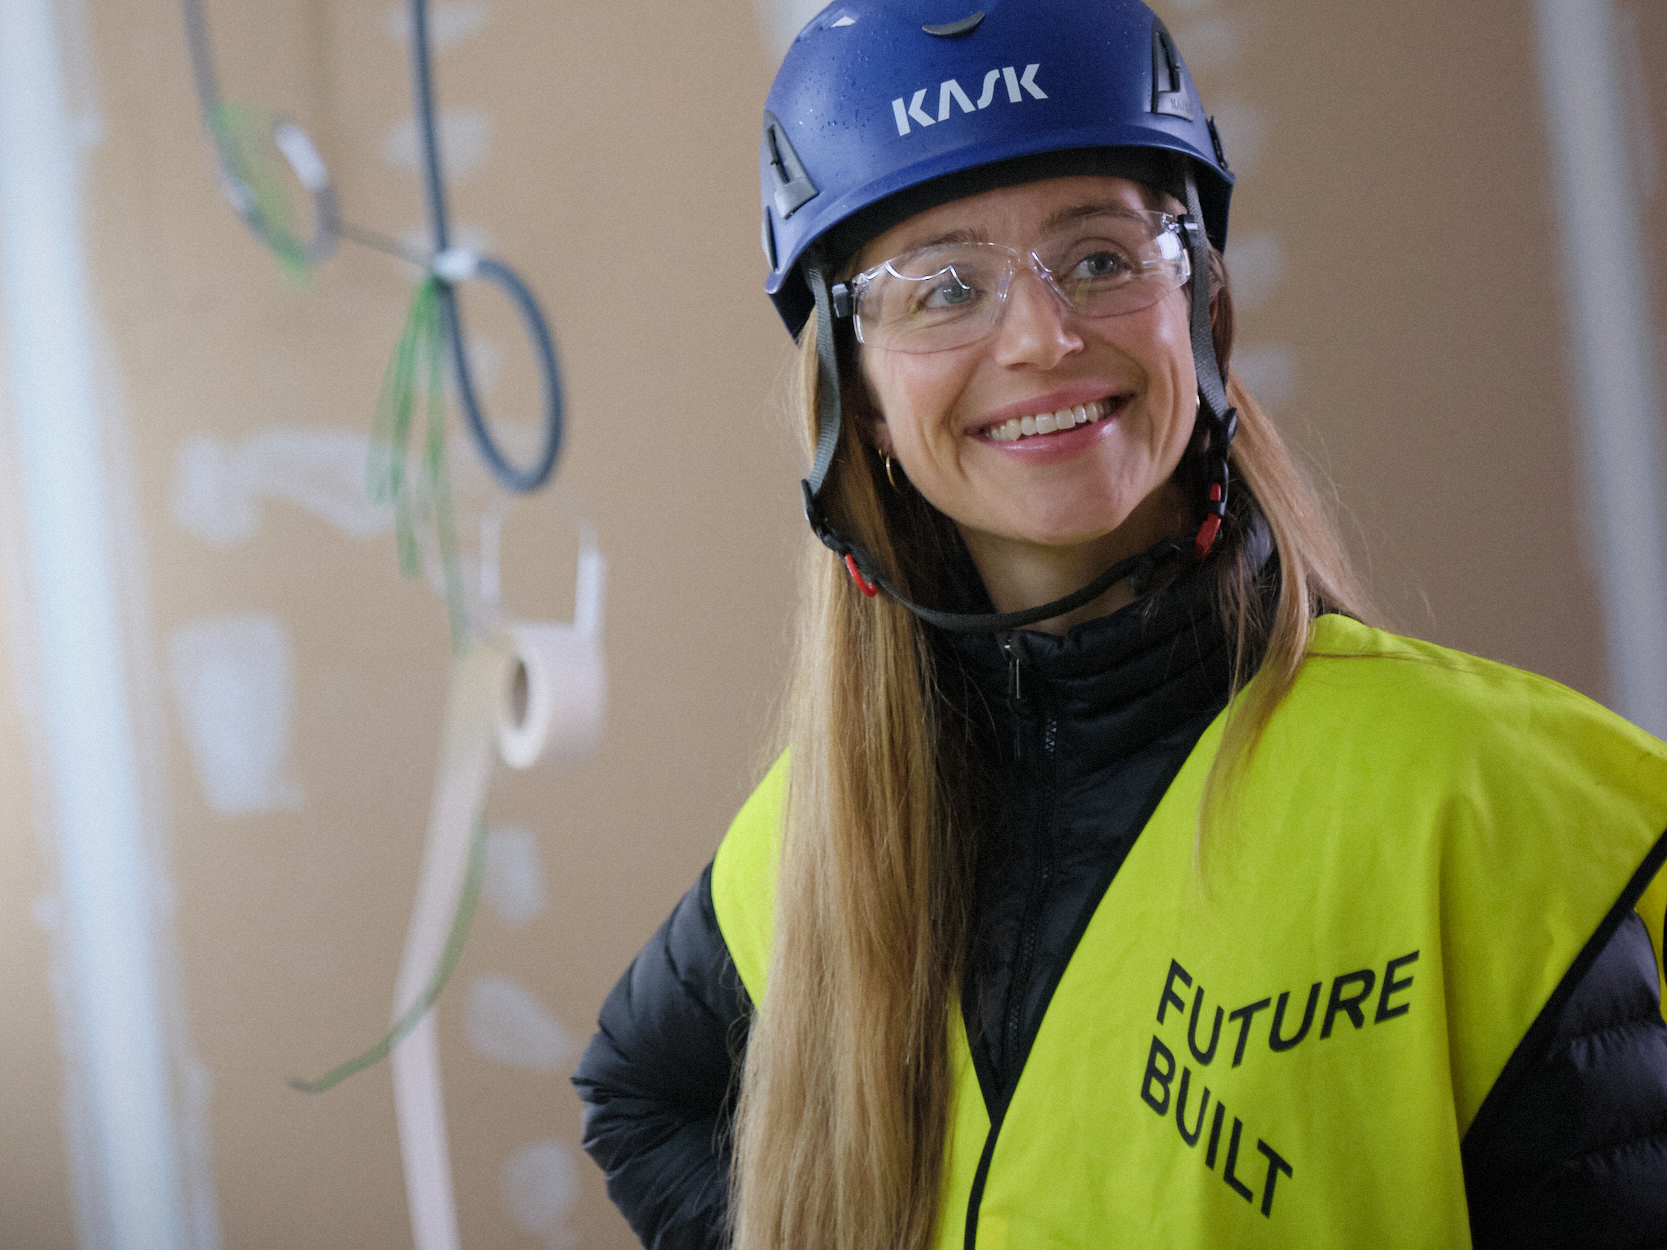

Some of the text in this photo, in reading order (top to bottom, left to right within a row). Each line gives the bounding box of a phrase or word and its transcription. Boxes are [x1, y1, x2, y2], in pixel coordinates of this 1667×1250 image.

[891, 63, 1049, 137] KASK
[1156, 950, 1420, 1069] FUTURE
[1140, 1034, 1294, 1220] BUILT
